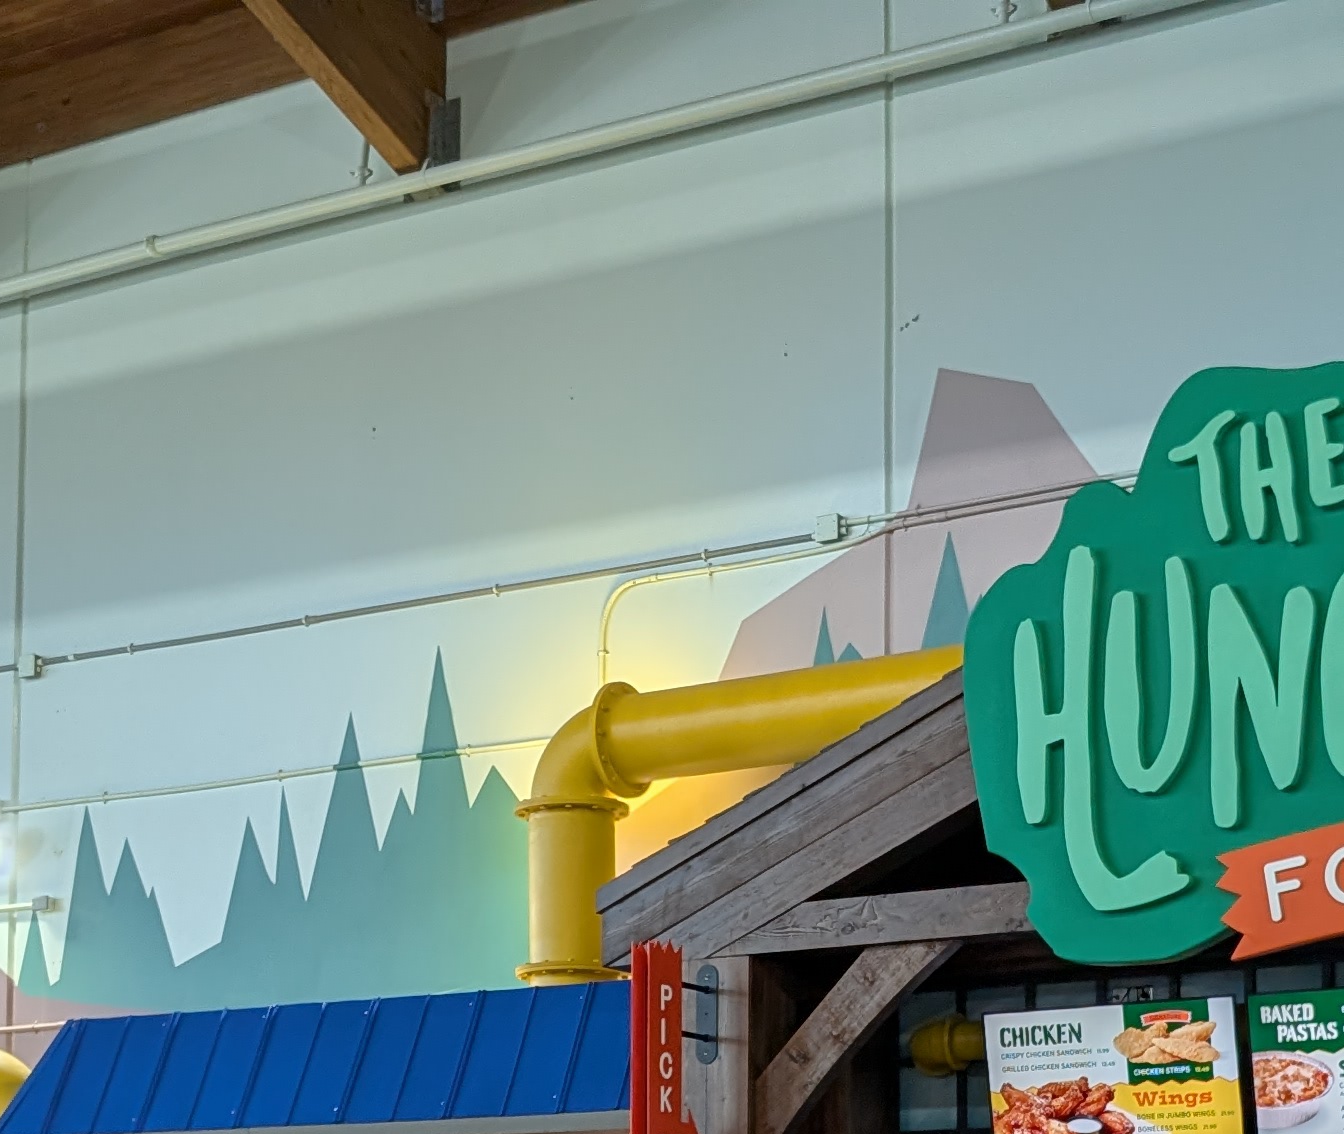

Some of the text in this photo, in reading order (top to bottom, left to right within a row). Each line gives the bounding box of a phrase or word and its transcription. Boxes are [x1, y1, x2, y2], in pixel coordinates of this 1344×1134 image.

[1260, 1003, 1314, 1024] BAKED
[999, 1022, 1082, 1048] CHICKEN
[1277, 1021, 1339, 1043] PASTAS
[659, 984, 673, 1113] PICK
[1001, 1052, 1024, 1060] CRISPY
[1026, 1050, 1054, 1058] CHICKEN
[1056, 1048, 1092, 1056] SANDWICH
[1002, 1065, 1030, 1073] GRILLED
[1030, 1063, 1059, 1071] CHICKEN
[1061, 1061, 1097, 1070] SANDWICH
[1133, 1067, 1164, 1076] CHICKEN
[1166, 1065, 1191, 1074] STRIPS
[1132, 1090, 1213, 1108] Wings
[1166, 1111, 1191, 1119] JUMBO
